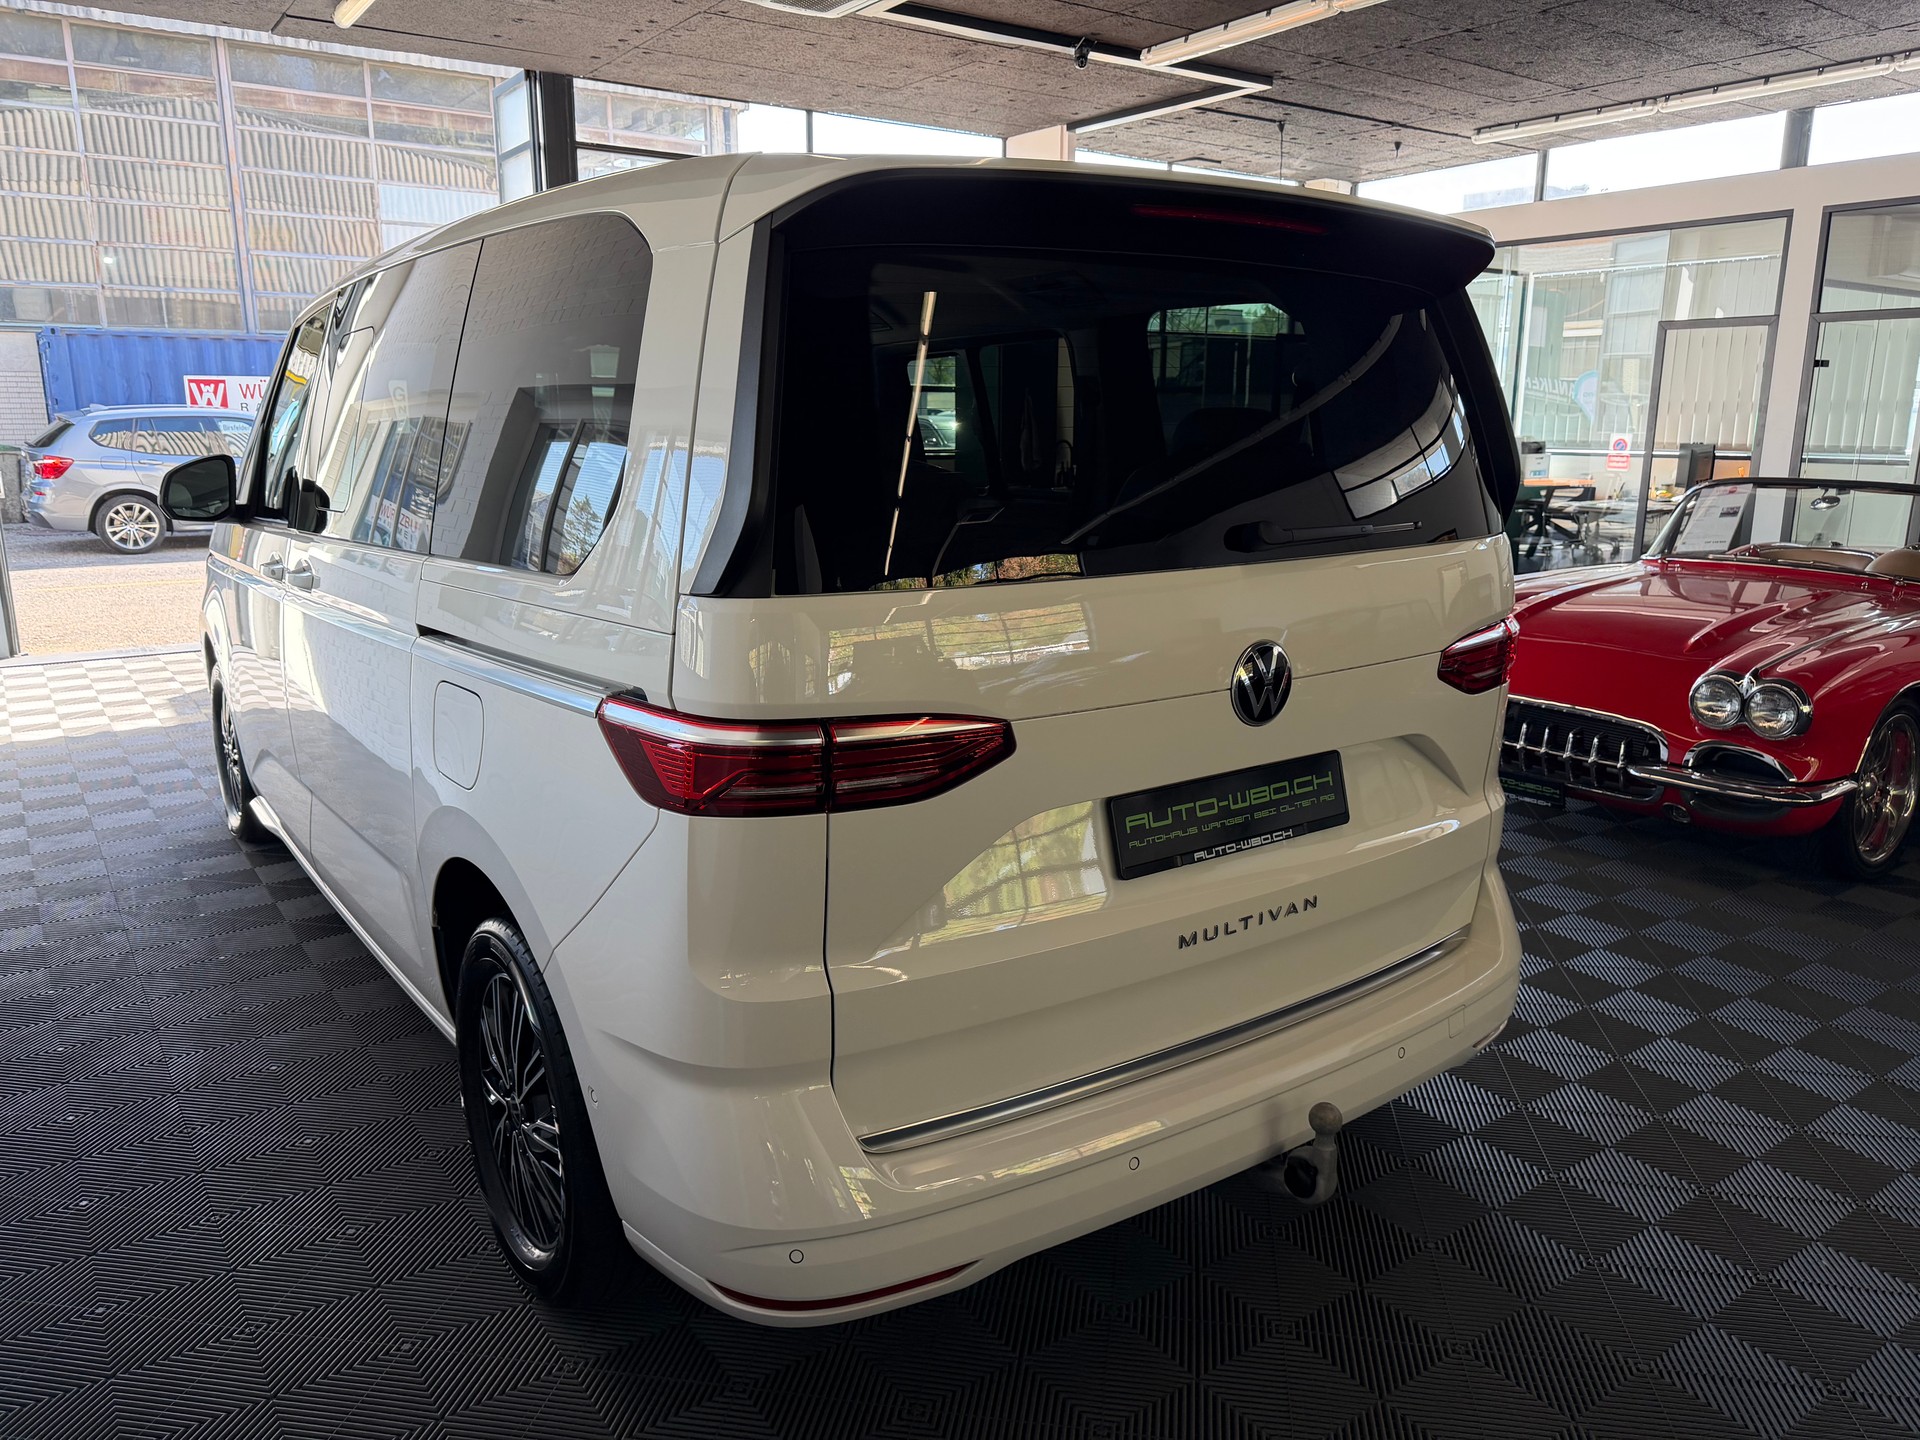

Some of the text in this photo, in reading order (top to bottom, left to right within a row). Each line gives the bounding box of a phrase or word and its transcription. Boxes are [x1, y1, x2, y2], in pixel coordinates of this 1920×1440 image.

[1125, 771, 1334, 833] AUTO-WBO.CH
[1500, 776, 1560, 794] TO-WBO.CH
[1128, 792, 1335, 849] AUTOHAUS WANGEN BEI OLTEN AG
[1193, 828, 1294, 861] AUTO-WBO.CH
[1178, 895, 1318, 949] MULTIVAN
